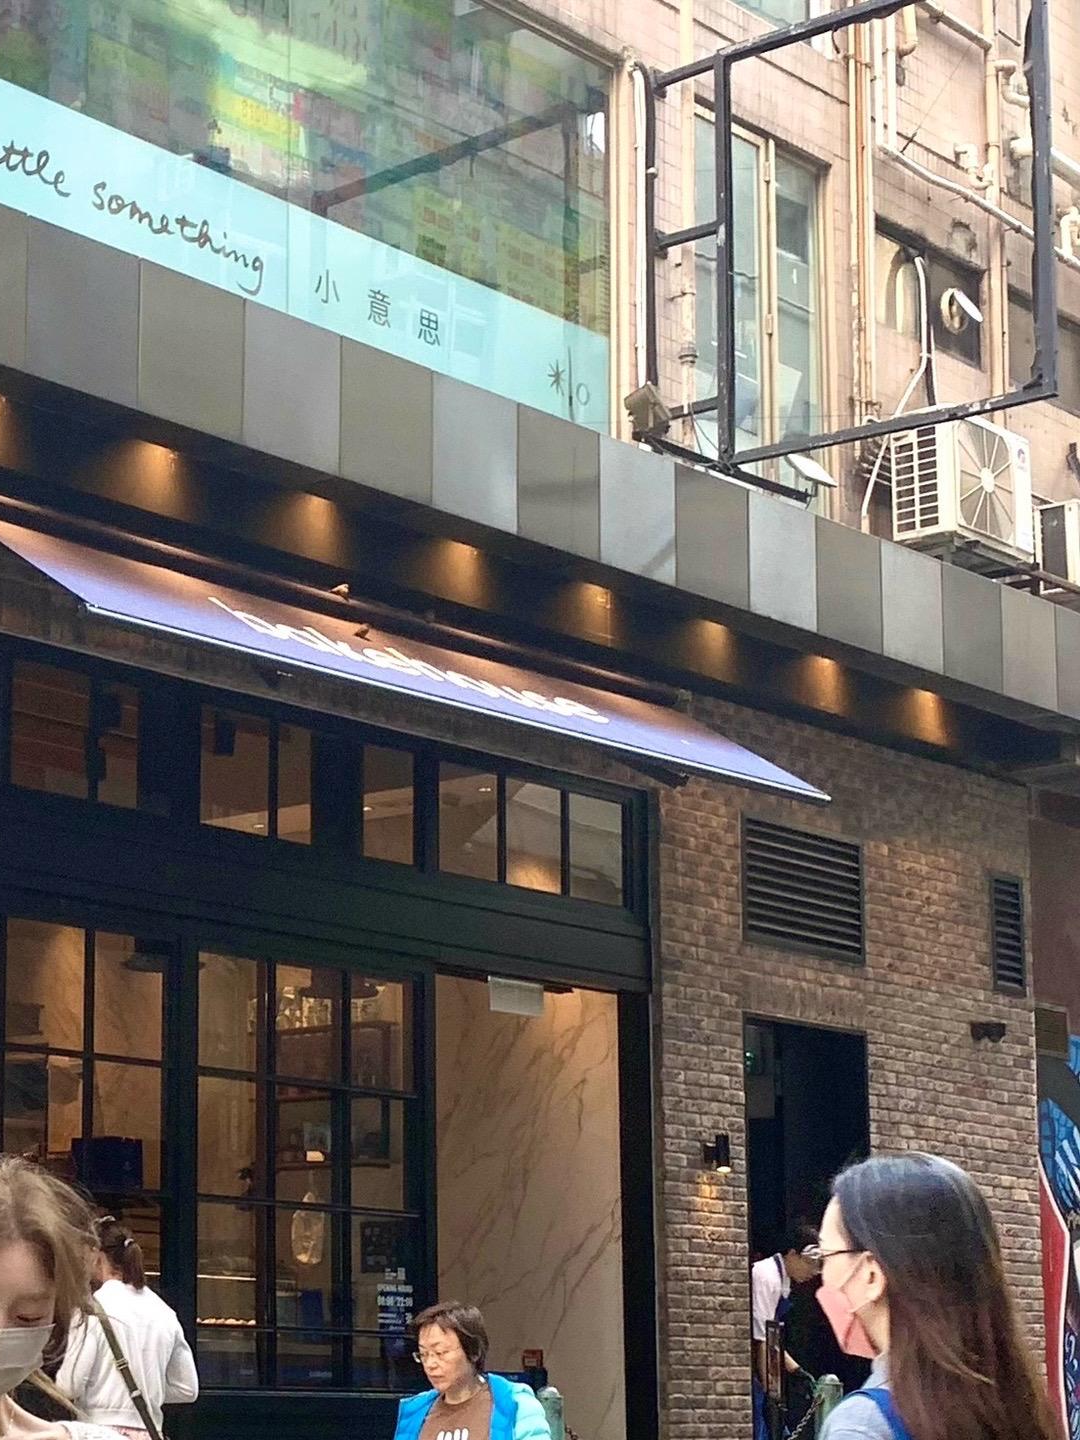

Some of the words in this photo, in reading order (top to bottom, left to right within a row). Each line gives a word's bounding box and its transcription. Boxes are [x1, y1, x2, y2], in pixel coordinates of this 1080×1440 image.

[93, 181, 264, 296] something
[314, 269, 441, 347] 小意思
[208, 597, 610, 725] bakehouse
